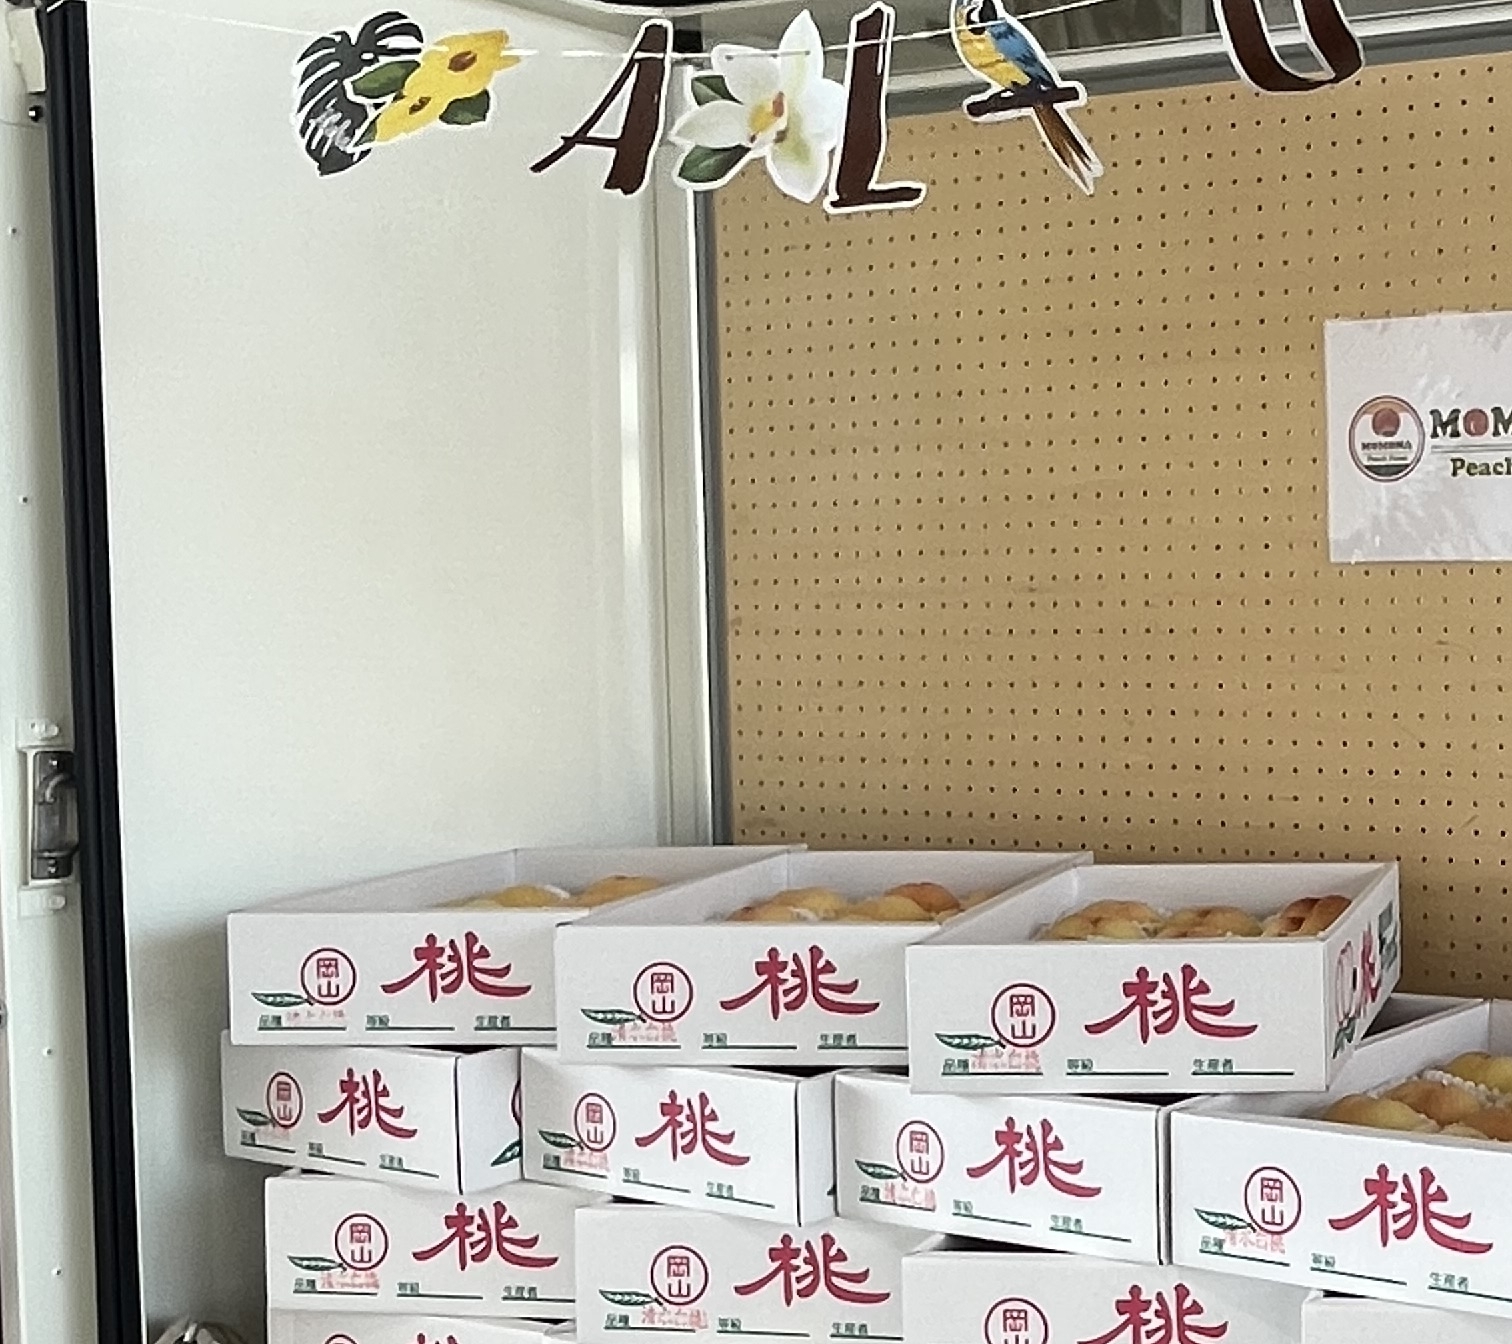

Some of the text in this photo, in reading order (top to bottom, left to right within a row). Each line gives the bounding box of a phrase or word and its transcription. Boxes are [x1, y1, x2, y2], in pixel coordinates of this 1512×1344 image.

[380, 931, 532, 1003] 桃
[719, 945, 880, 1021] 桃
[1084, 964, 1259, 1045] 桃
[317, 1067, 418, 1140] 桃
[634, 1089, 751, 1166] 桃
[966, 1116, 1103, 1198] 桃
[412, 1200, 560, 1272] 桃
[1328, 1163, 1494, 1254] 桃
[734, 1233, 892, 1307] 桃
